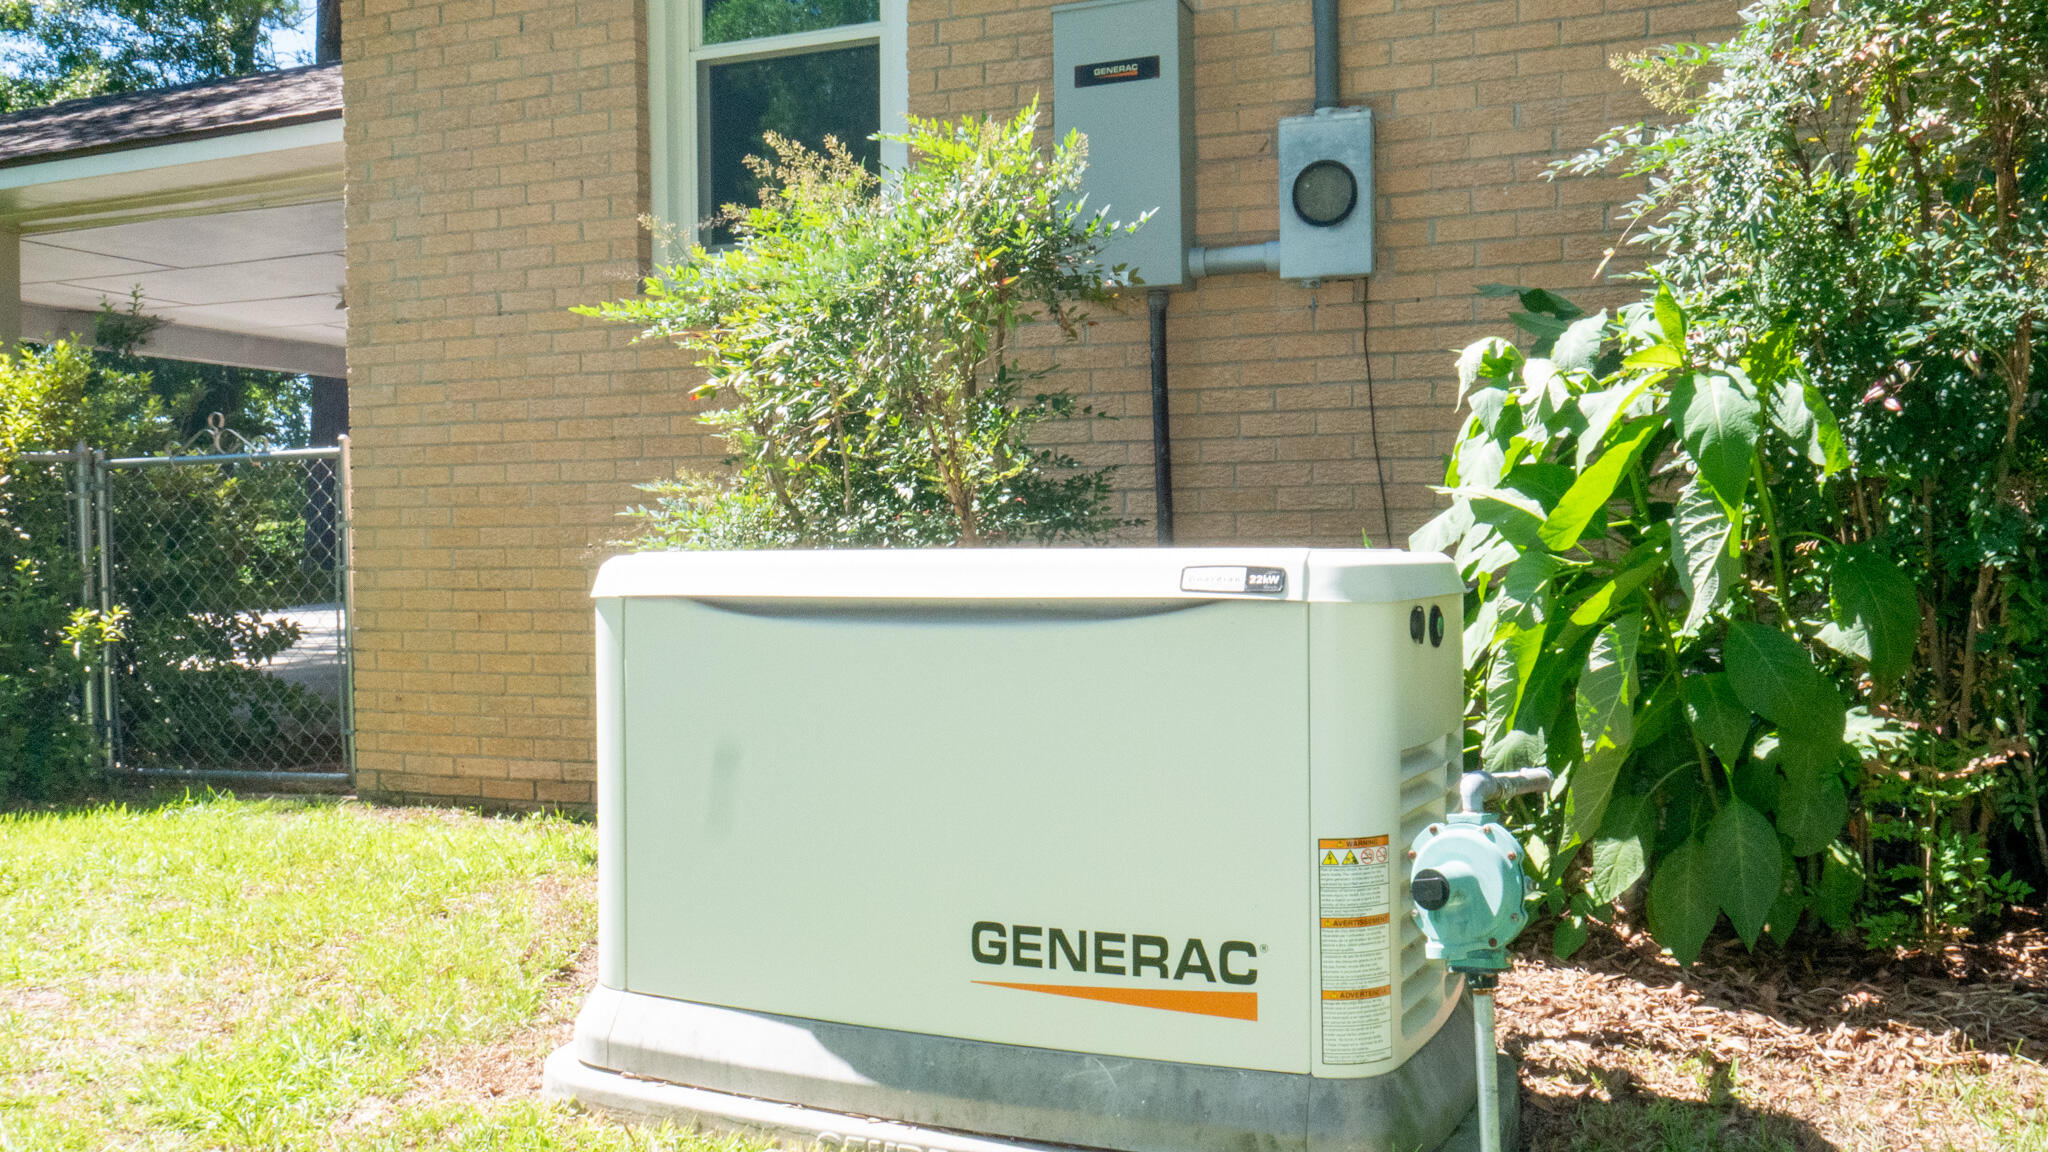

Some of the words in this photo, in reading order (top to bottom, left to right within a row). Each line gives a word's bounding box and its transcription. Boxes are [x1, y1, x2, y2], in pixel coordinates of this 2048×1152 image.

[1093, 63, 1139, 76] GENERAC
[1249, 574, 1280, 585] 22kW
[1346, 839, 1378, 848] WARNING
[970, 920, 1259, 986] GENERAC
